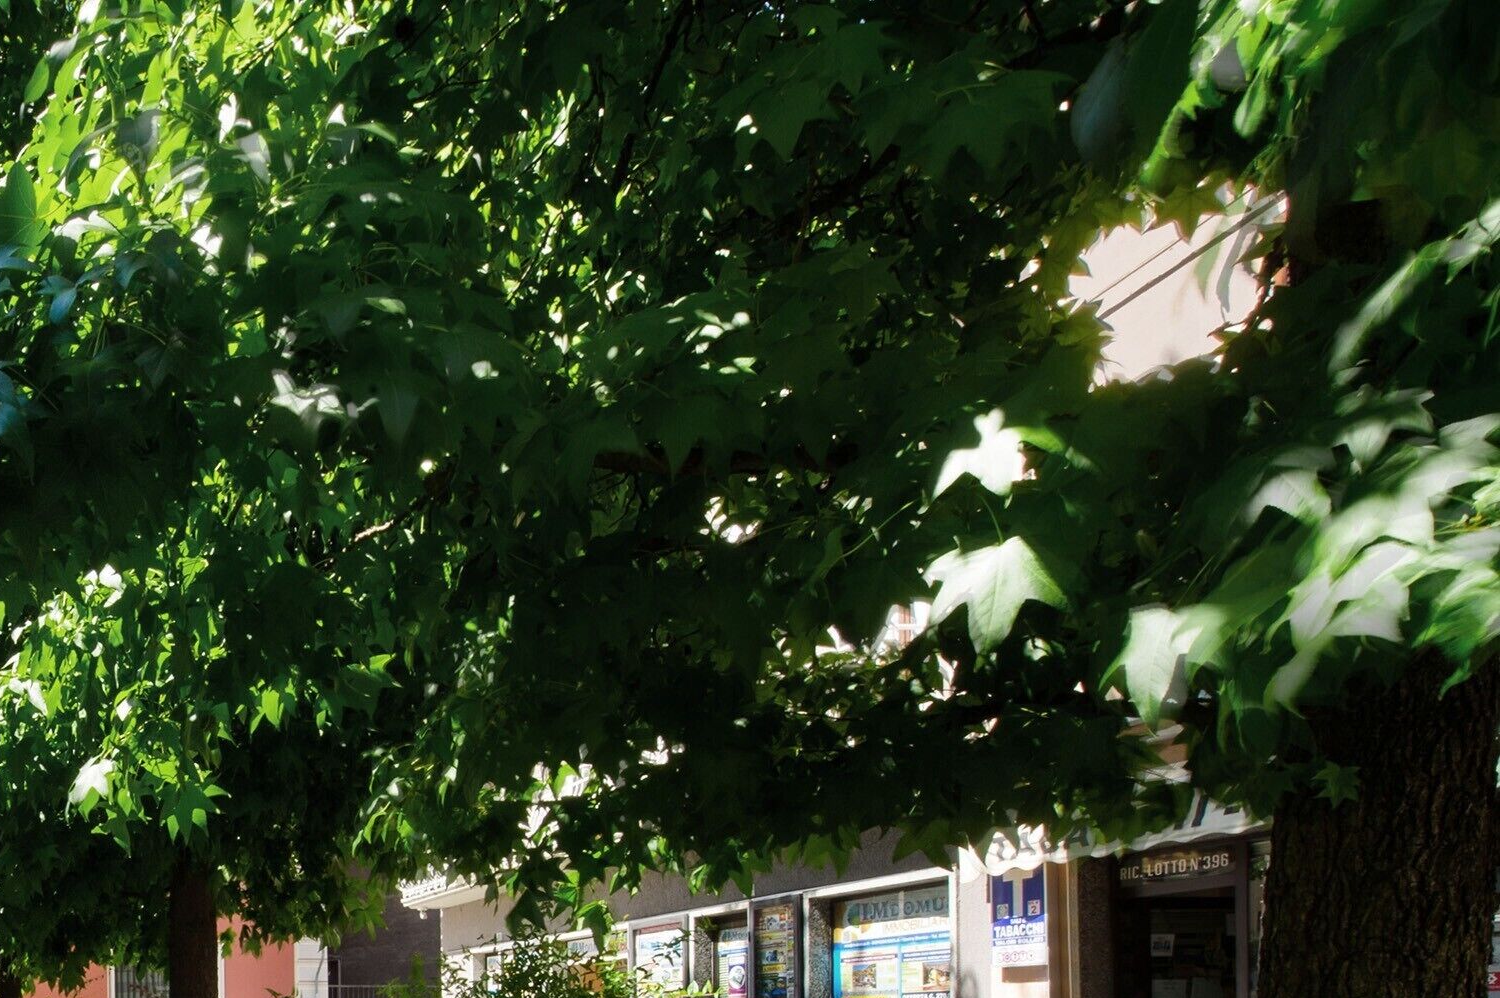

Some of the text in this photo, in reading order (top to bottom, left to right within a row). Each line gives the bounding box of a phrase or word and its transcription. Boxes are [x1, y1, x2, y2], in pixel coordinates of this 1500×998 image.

[1119, 865, 1143, 880] RIC.
[1147, 858, 1187, 876] LOTTO
[993, 923, 1044, 938] TABACCHI
